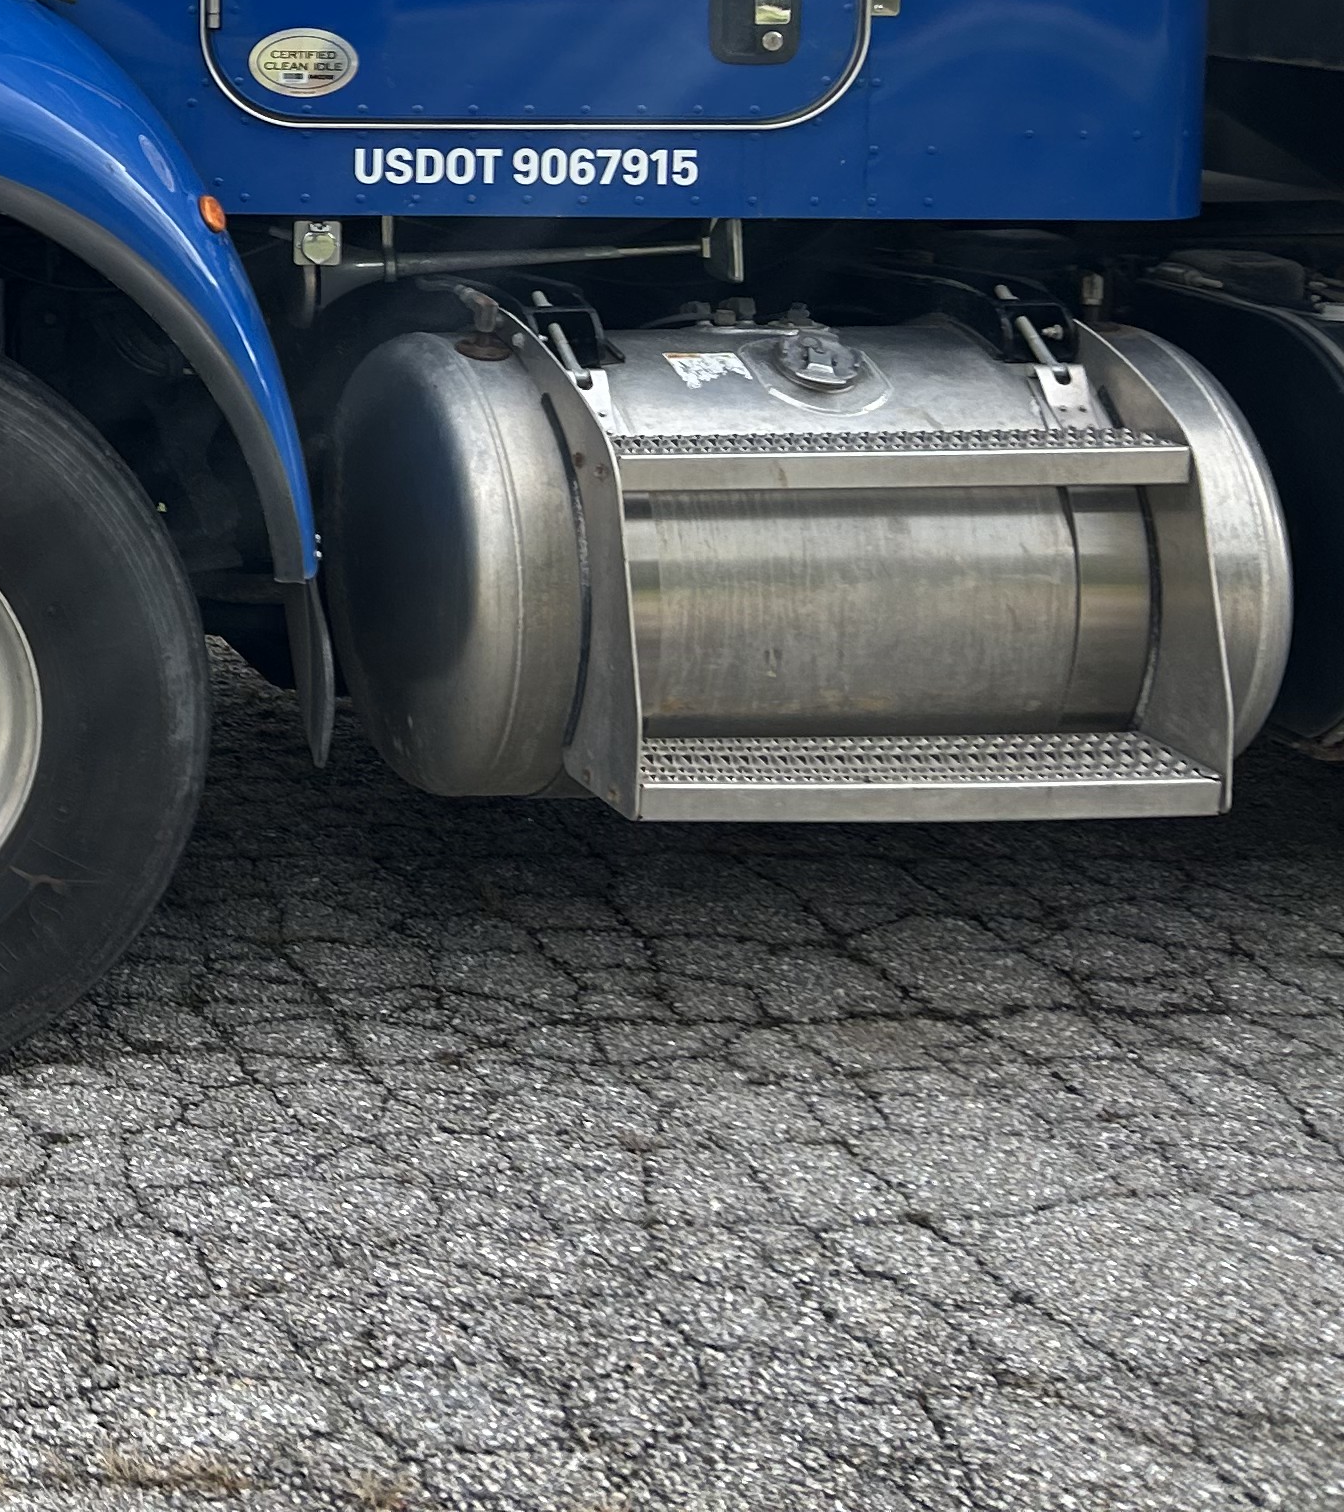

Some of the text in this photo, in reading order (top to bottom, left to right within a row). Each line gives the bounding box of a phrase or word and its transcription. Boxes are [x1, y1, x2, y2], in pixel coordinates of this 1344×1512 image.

[270, 50, 337, 60] CERTIFIED
[263, 61, 344, 72] CLEAN IDLE
[354, 146, 699, 187] USDOT 9067915
